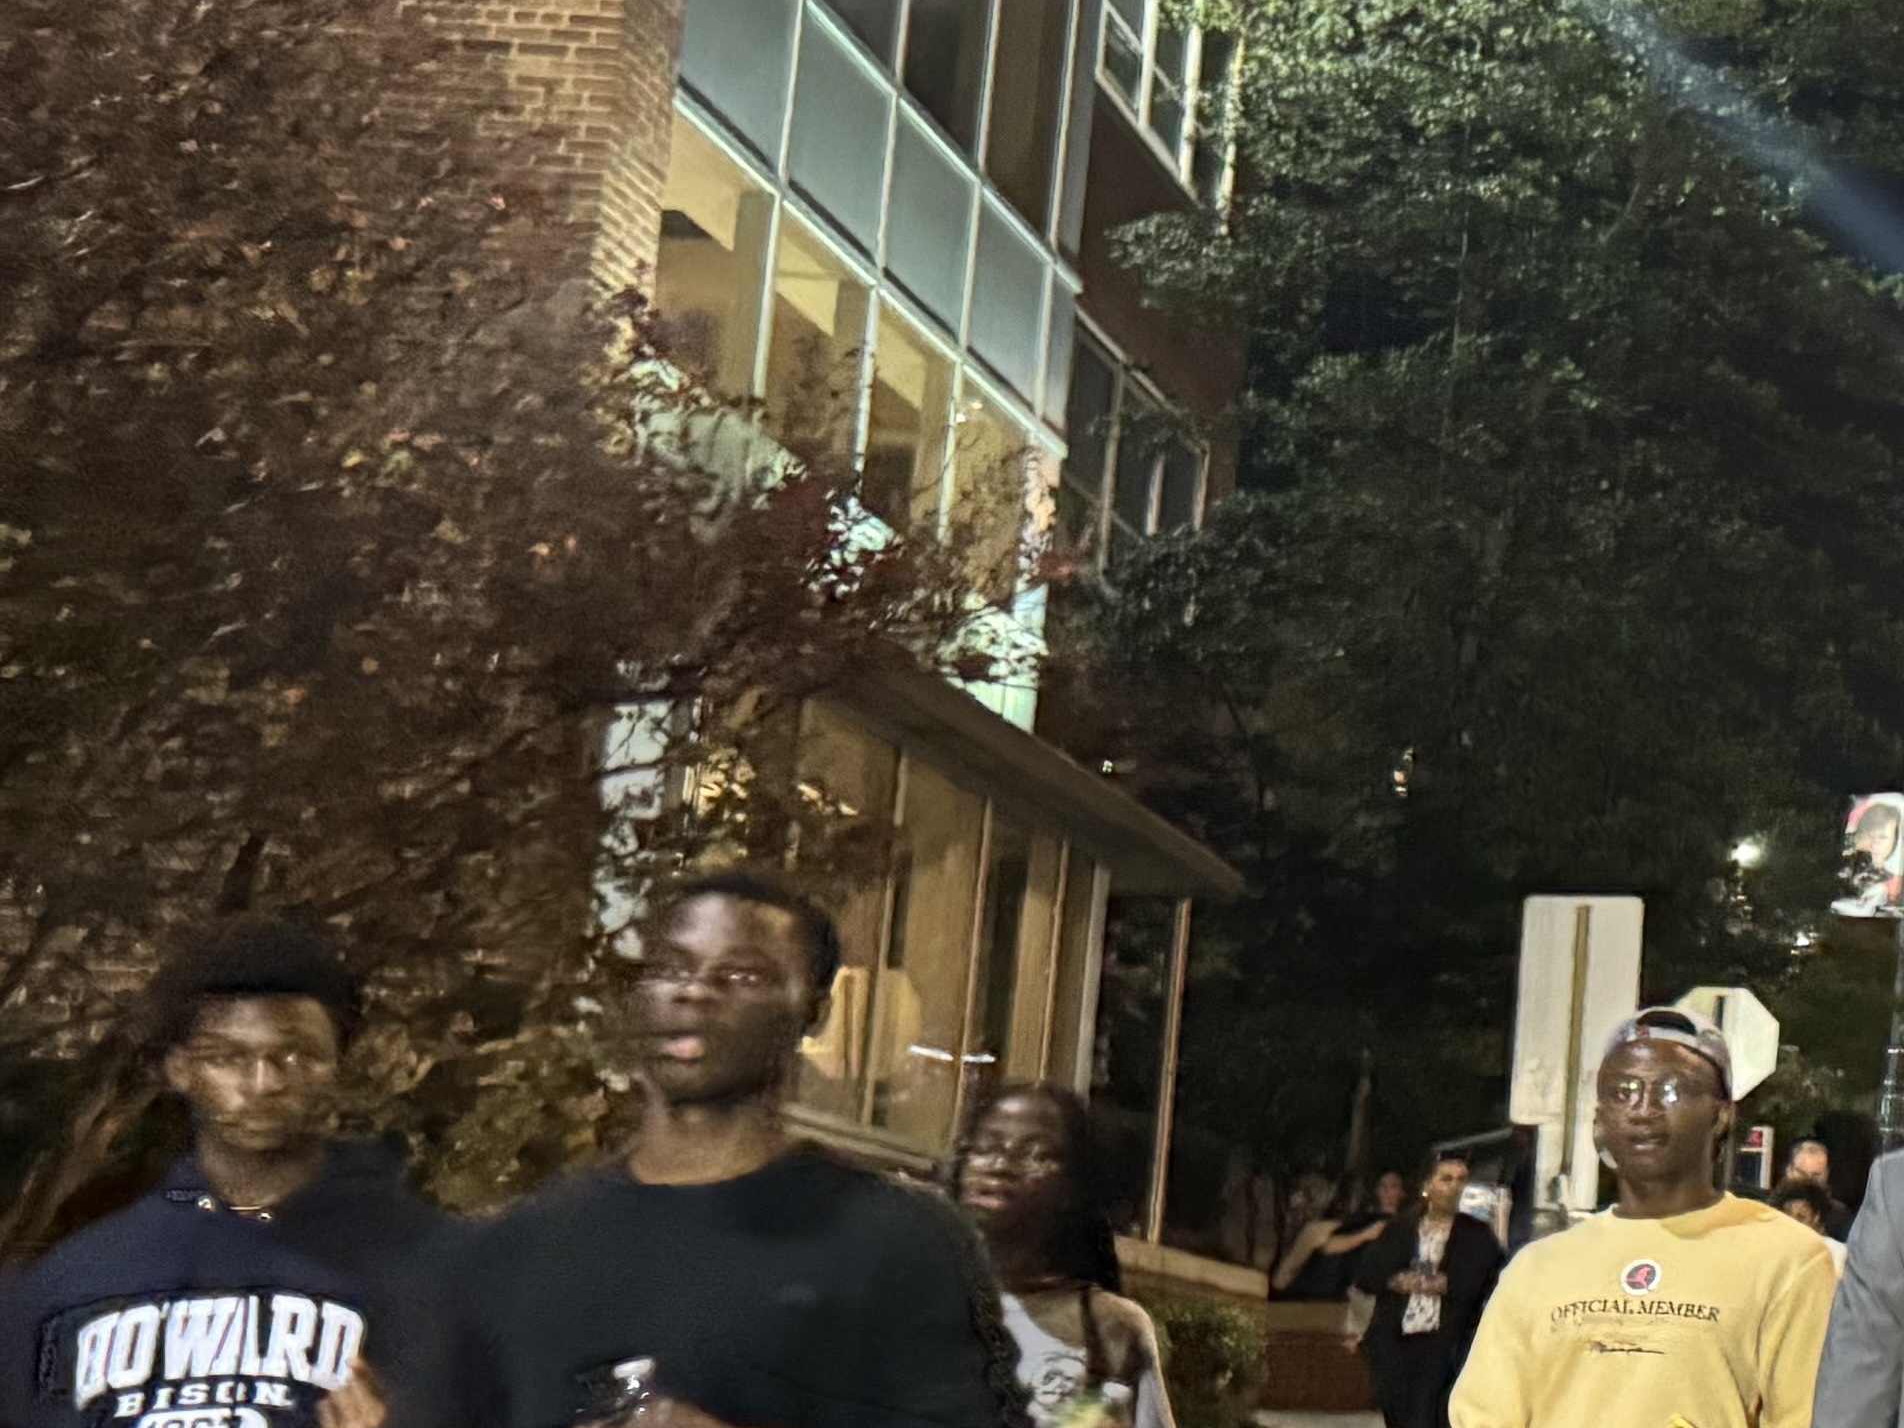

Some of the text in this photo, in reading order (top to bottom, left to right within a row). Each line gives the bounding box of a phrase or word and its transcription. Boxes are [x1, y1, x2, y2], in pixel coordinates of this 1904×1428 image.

[1551, 1299, 1720, 1323] OFFICIAL MEMBER
[75, 1294, 364, 1411] HOWARD
[113, 1380, 294, 1418] BISON
